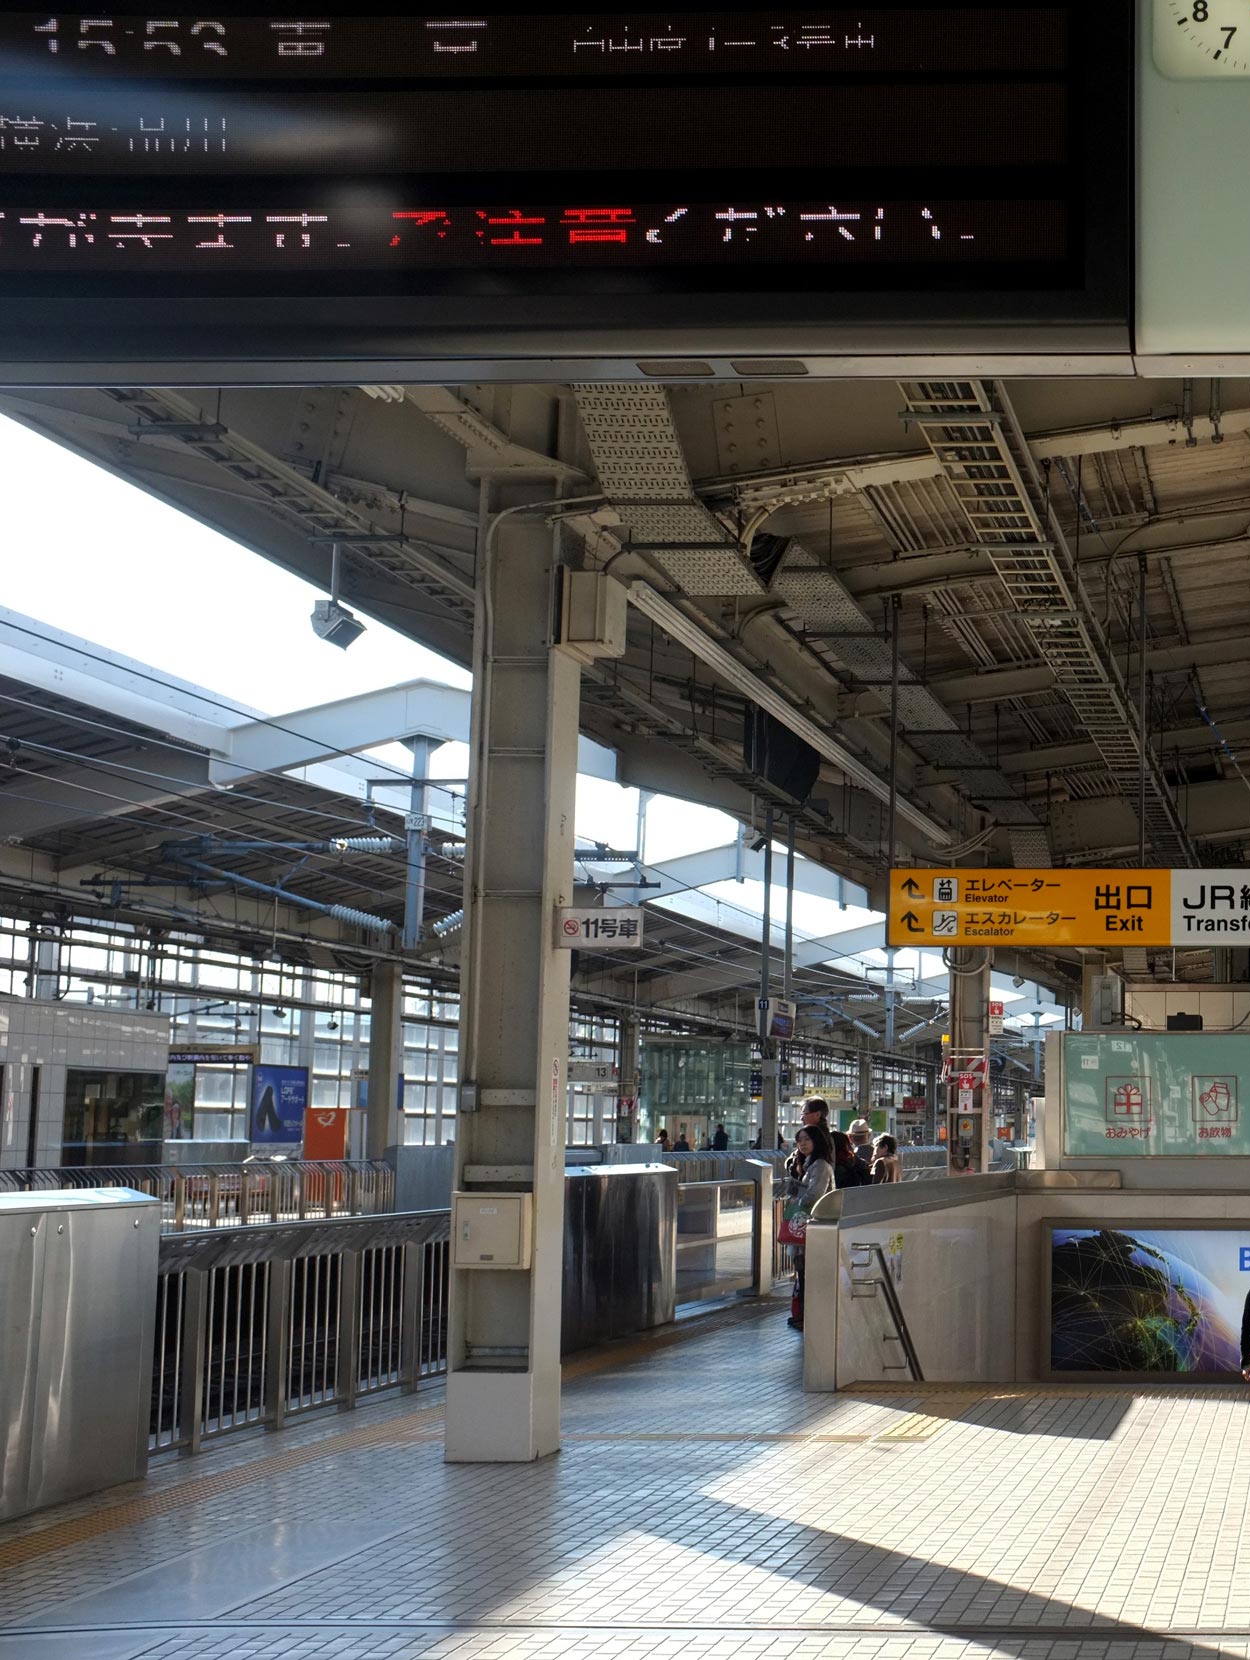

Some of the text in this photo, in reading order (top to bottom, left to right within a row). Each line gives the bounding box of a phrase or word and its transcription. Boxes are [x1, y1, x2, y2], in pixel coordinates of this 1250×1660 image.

[1192, 0, 1208, 22] 8
[1220, 27, 1237, 49] 7
[965, 878, 1061, 892] エレベーター
[965, 894, 1009, 902] Elevator
[1095, 884, 1152, 910] 出口
[965, 912, 1076, 925] エスカレーター
[1105, 915, 1143, 931] Exit
[582, 918, 638, 938] 11号車
[965, 927, 1014, 936] Escalator
[596, 1067, 607, 1077] 13
[1105, 1127, 1151, 1139] おみやげ
[1198, 1127, 1232, 1138] お飲物
